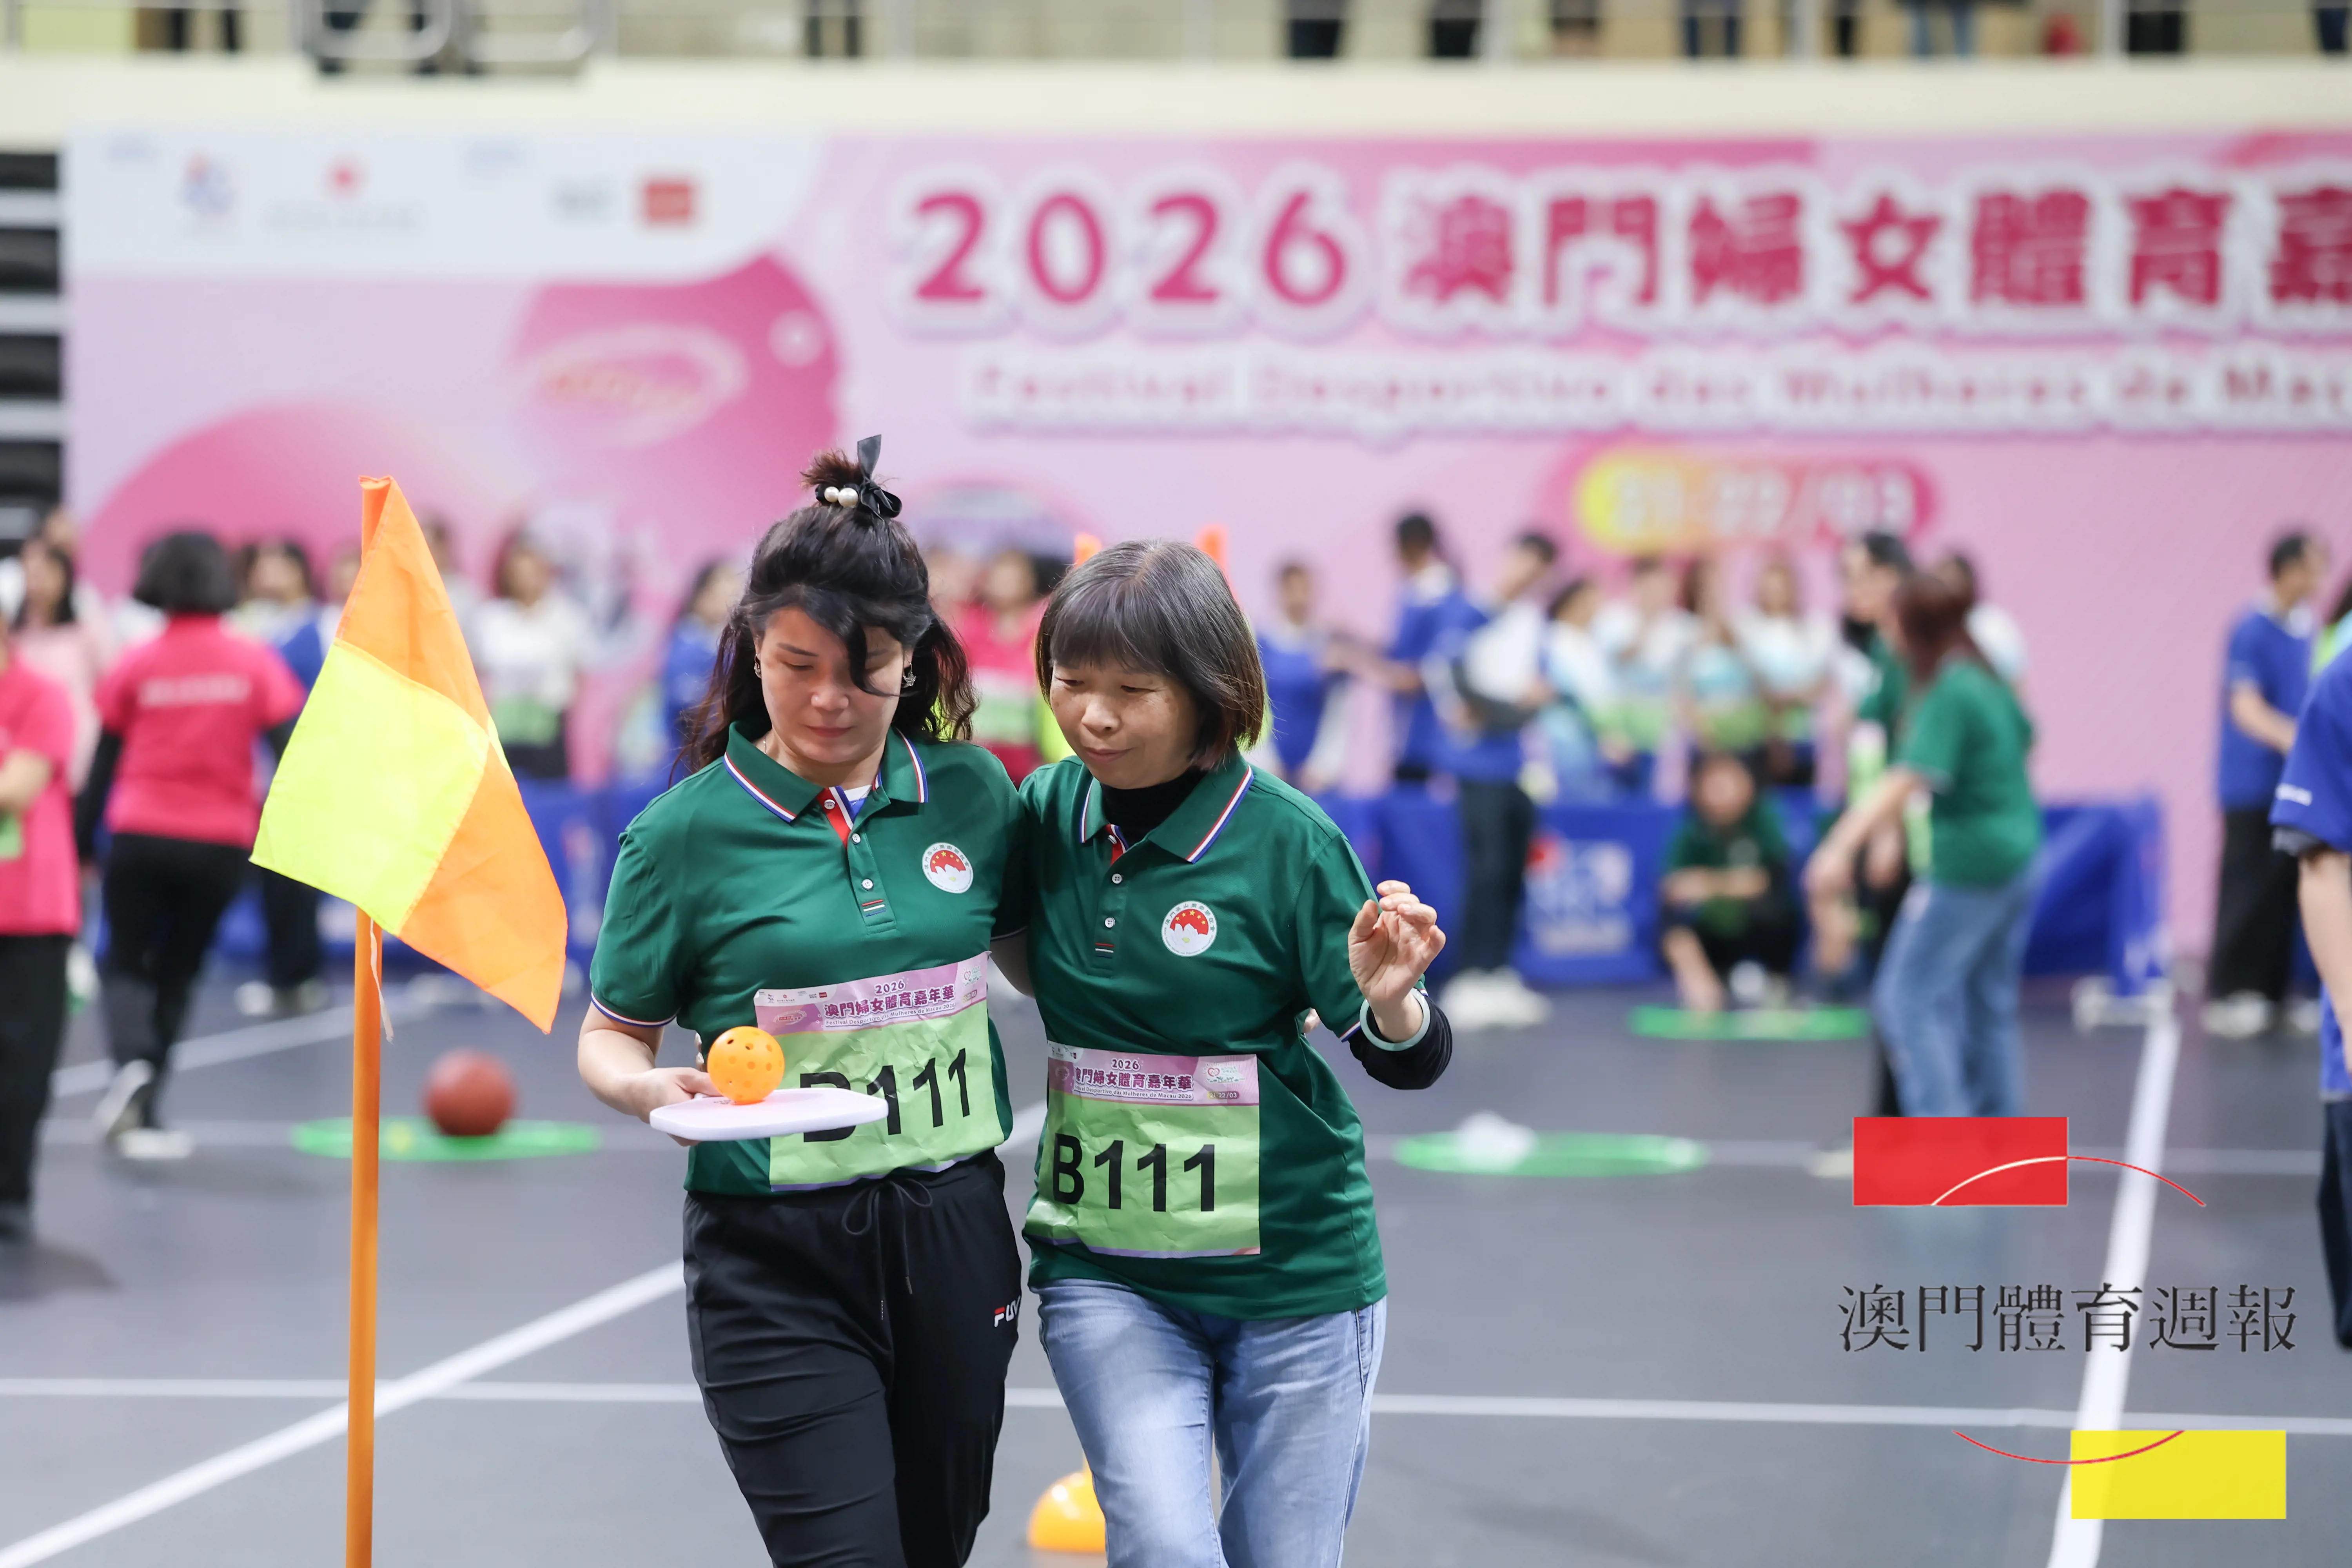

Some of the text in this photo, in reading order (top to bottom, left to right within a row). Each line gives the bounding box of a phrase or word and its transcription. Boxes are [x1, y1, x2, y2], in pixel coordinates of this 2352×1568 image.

[913, 191, 1346, 307] 2026
[824, 985, 954, 1016] 澳門婦女體育嘉年華
[875, 980, 904, 994] 2026
[1112, 1059, 1139, 1069] 2026
[1053, 1133, 1215, 1212] B111
